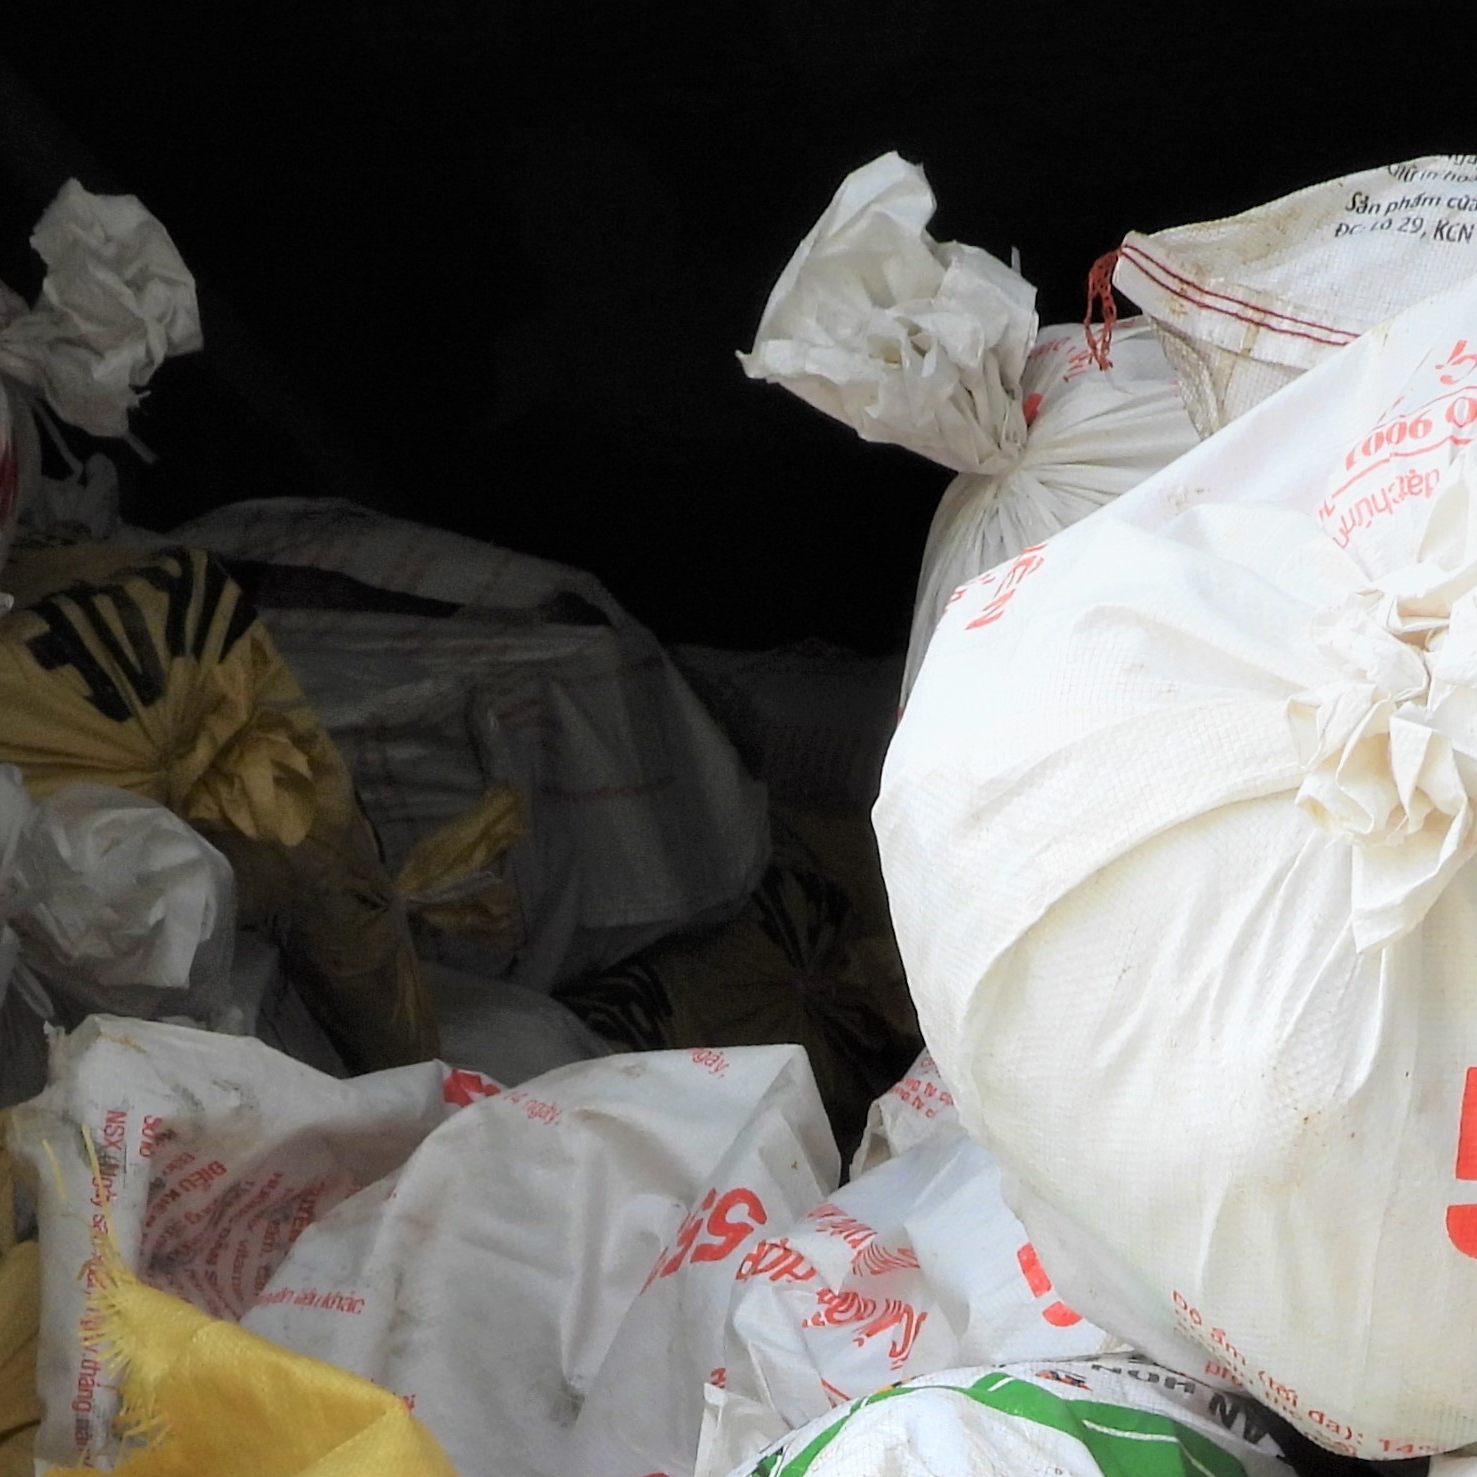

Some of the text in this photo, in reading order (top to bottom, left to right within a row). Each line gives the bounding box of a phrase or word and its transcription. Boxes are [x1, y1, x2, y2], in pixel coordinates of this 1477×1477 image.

[1345, 191, 1380, 216] Sản
[1433, 219, 1474, 244] KCN
[1344, 414, 1434, 472] 9001
[103, 1110, 127, 1151] NSX
